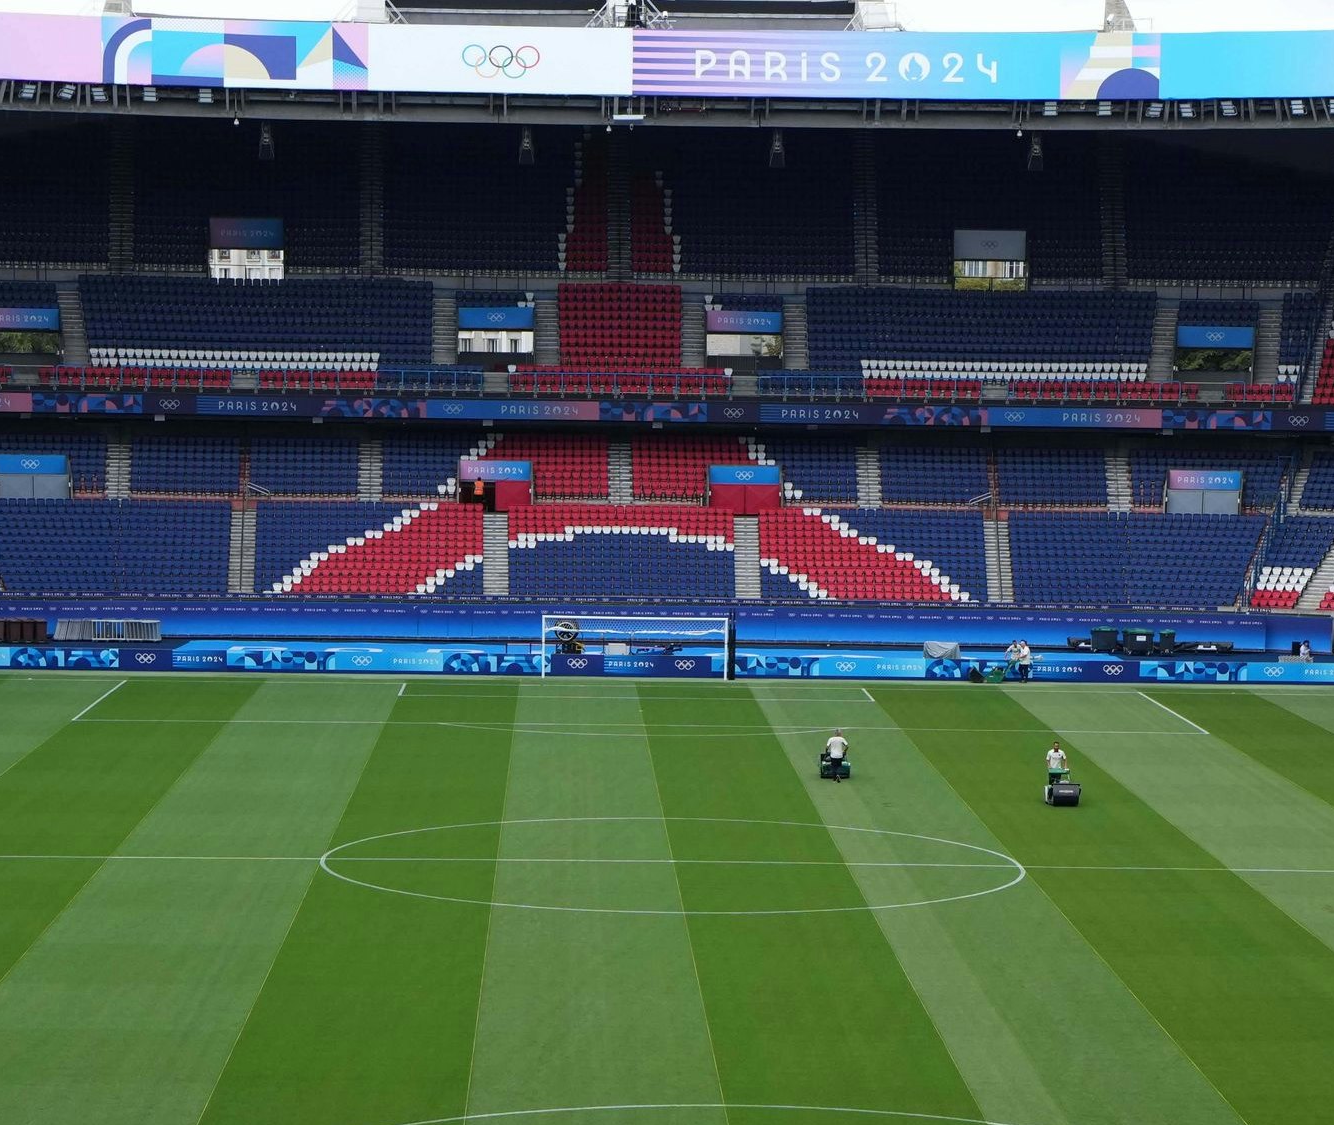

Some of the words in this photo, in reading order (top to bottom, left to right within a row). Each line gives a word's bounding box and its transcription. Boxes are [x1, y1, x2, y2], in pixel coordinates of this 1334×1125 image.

[694, 49, 842, 82] PARIS
[866, 52, 998, 83] 2024
[218, 401, 256, 410] PARIS
[262, 402, 297, 411] 2024
[501, 406, 539, 414] PARIS
[544, 406, 578, 415] 2024
[782, 410, 820, 418] PARIS
[825, 410, 859, 418] 2024
[1062, 413, 1100, 422] PARIS
[1106, 414, 1140, 422] 2024
